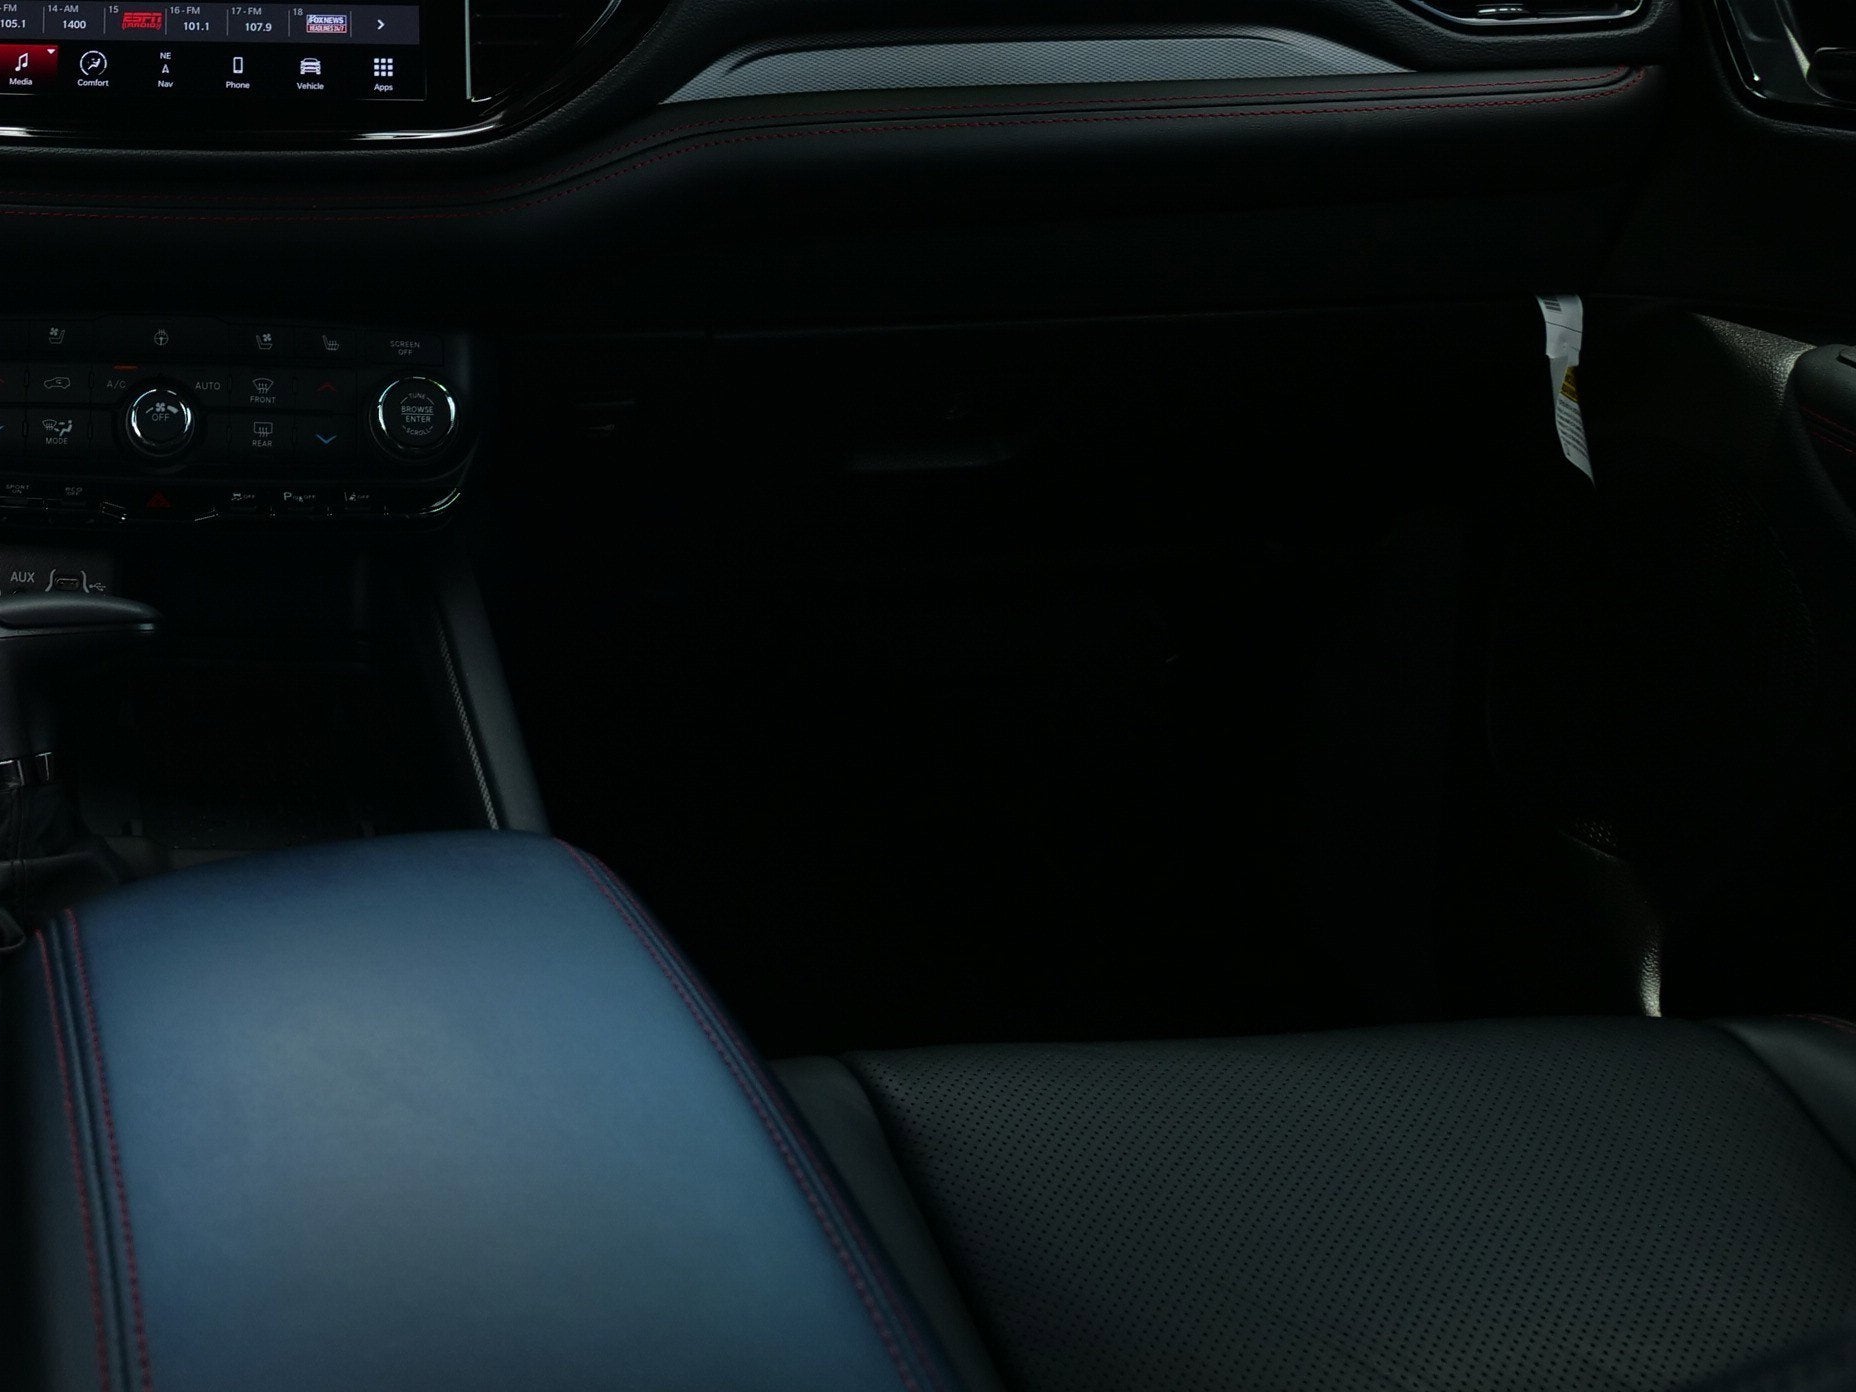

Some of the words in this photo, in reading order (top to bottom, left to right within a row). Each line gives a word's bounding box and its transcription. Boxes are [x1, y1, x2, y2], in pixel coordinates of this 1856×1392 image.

[108, 5, 119, 14] 15
[293, 8, 304, 16] 18
[123, 12, 163, 23] ESPN
[0, 19, 26, 28] 105.1
[63, 20, 87, 29] 1400
[183, 22, 210, 31] 101.1
[245, 22, 272, 32] 107.9
[160, 52, 172, 60] NE
[9, 78, 33, 86] Media
[77, 79, 109, 87] Comfort
[158, 80, 174, 88] Nav
[225, 81, 250, 89] Phone
[296, 82, 325, 90] Vehicle
[374, 83, 394, 92] Apps
[389, 340, 420, 348] SCREEN
[106, 380, 126, 389] A/C
[195, 382, 221, 390] AUTO
[250, 396, 276, 404] FRONT
[401, 405, 434, 413] BROWSE
[151, 413, 170, 422] OFF
[405, 428, 431, 436] SCROLL
[45, 437, 69, 445] MODE
[10, 572, 35, 583] AUX
